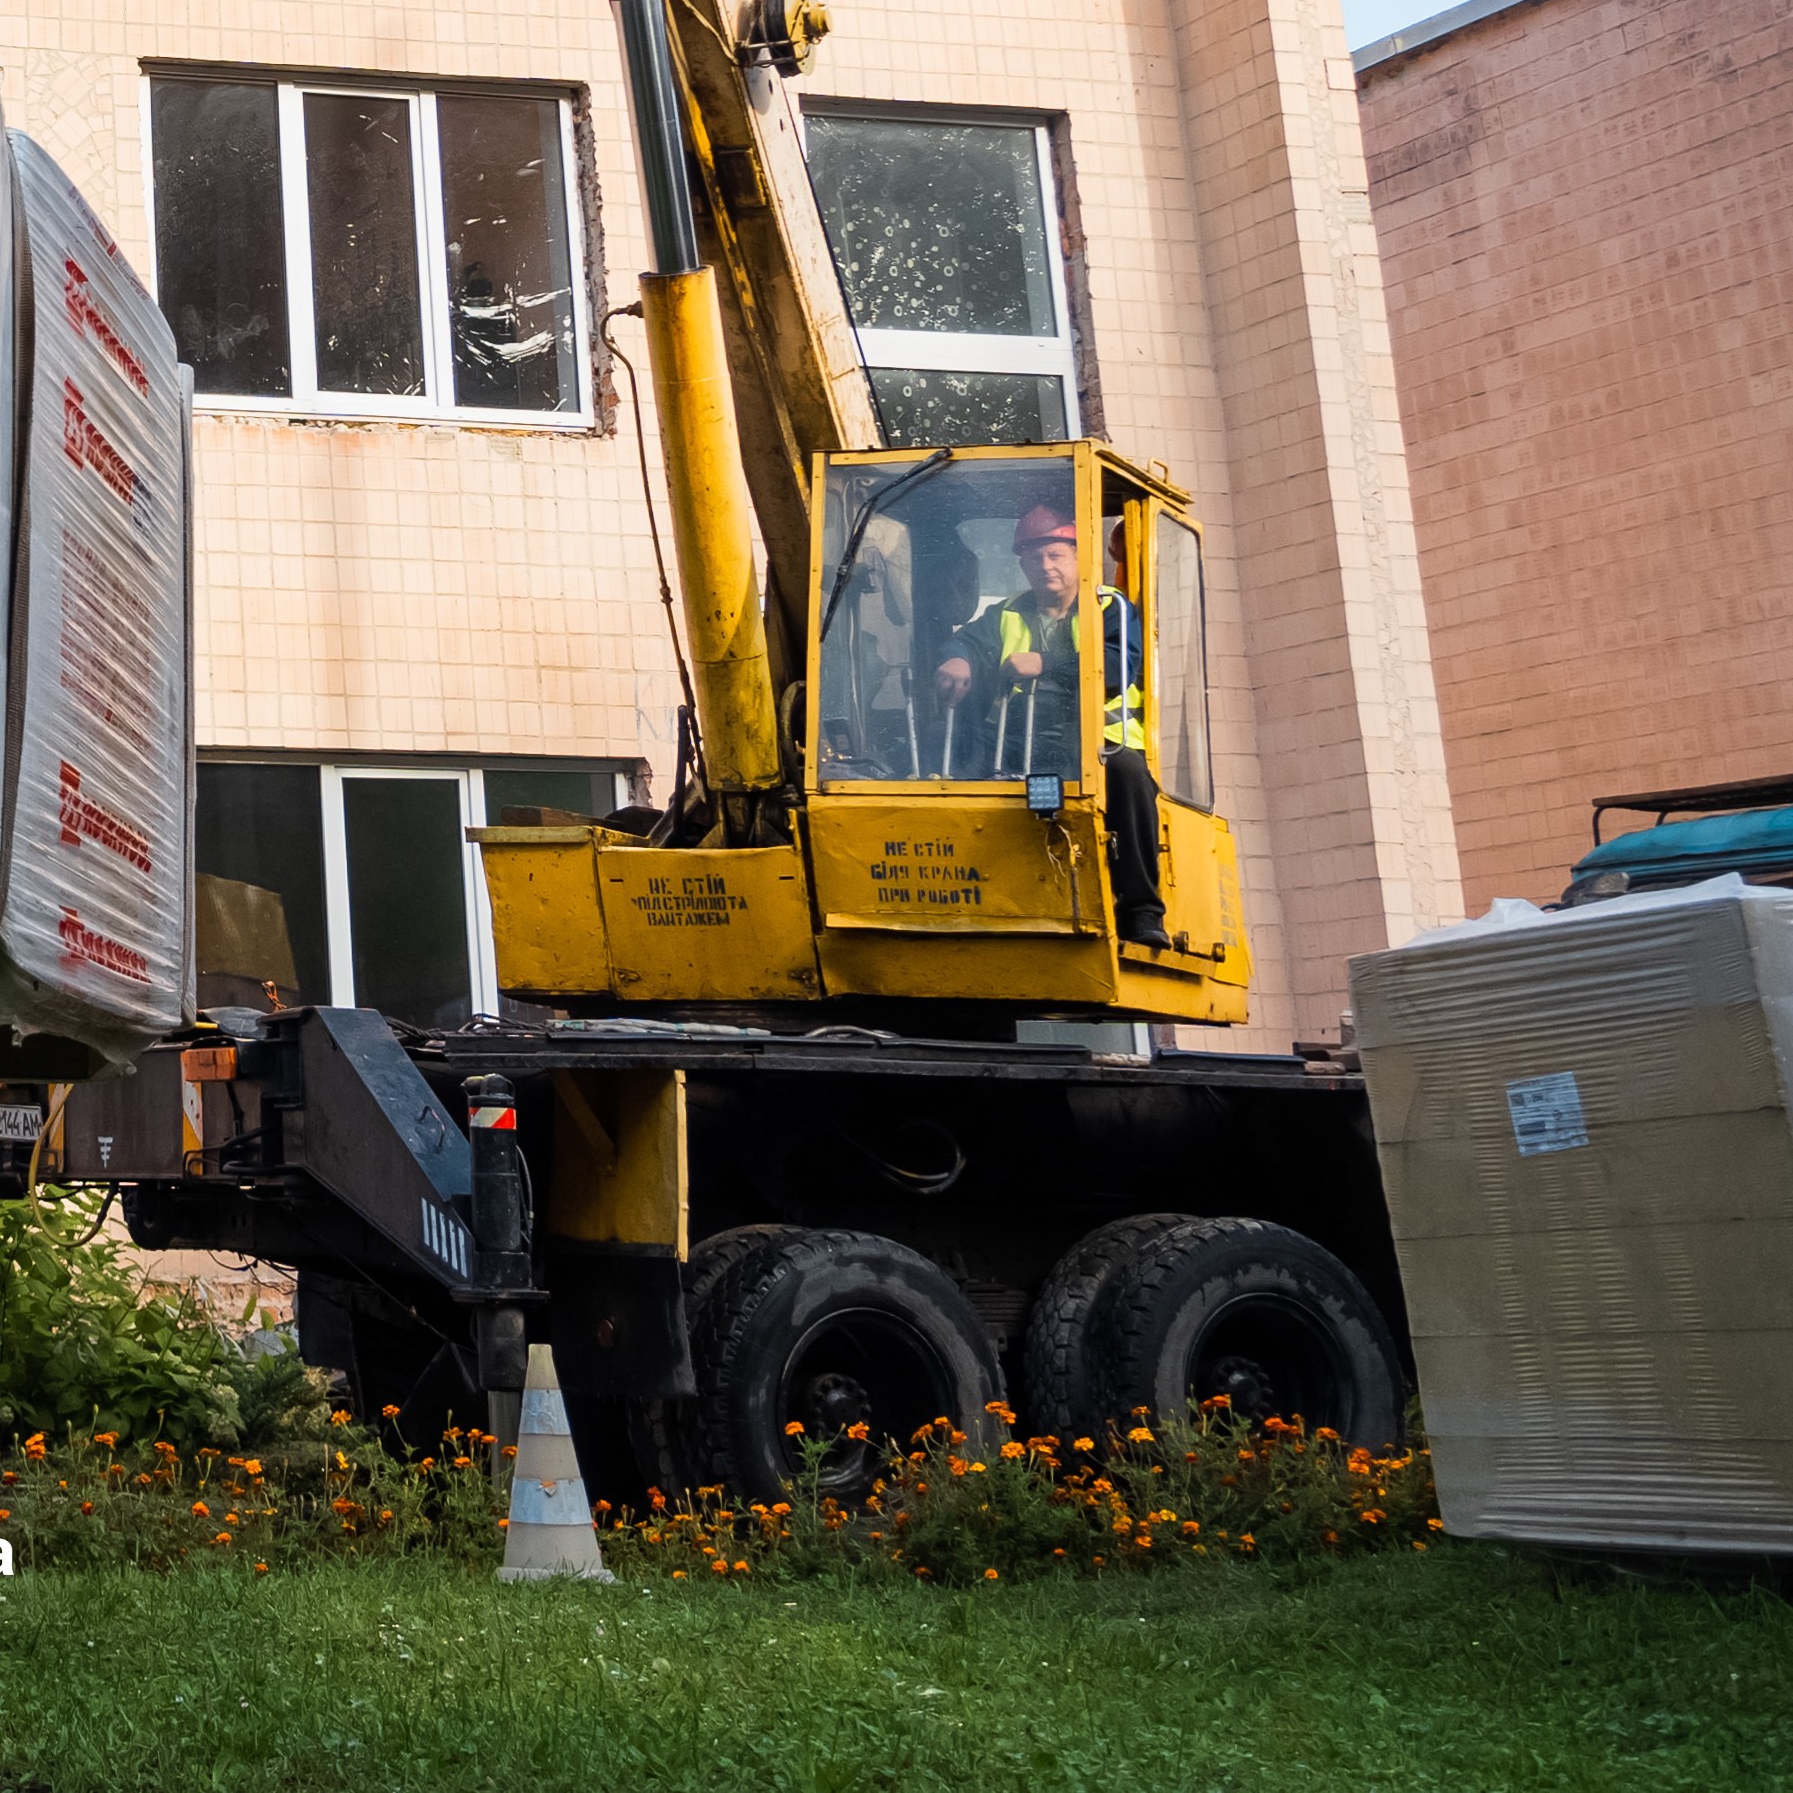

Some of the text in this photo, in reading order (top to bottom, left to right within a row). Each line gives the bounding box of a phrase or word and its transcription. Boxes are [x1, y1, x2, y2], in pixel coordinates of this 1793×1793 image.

[884, 841, 908, 857] НЕ
[918, 866, 981, 882] КРАНА
[648, 877, 673, 895] НЕ
[878, 887, 911, 903] ПРИ
[646, 912, 731, 927] ВАНТАЖЕМ
